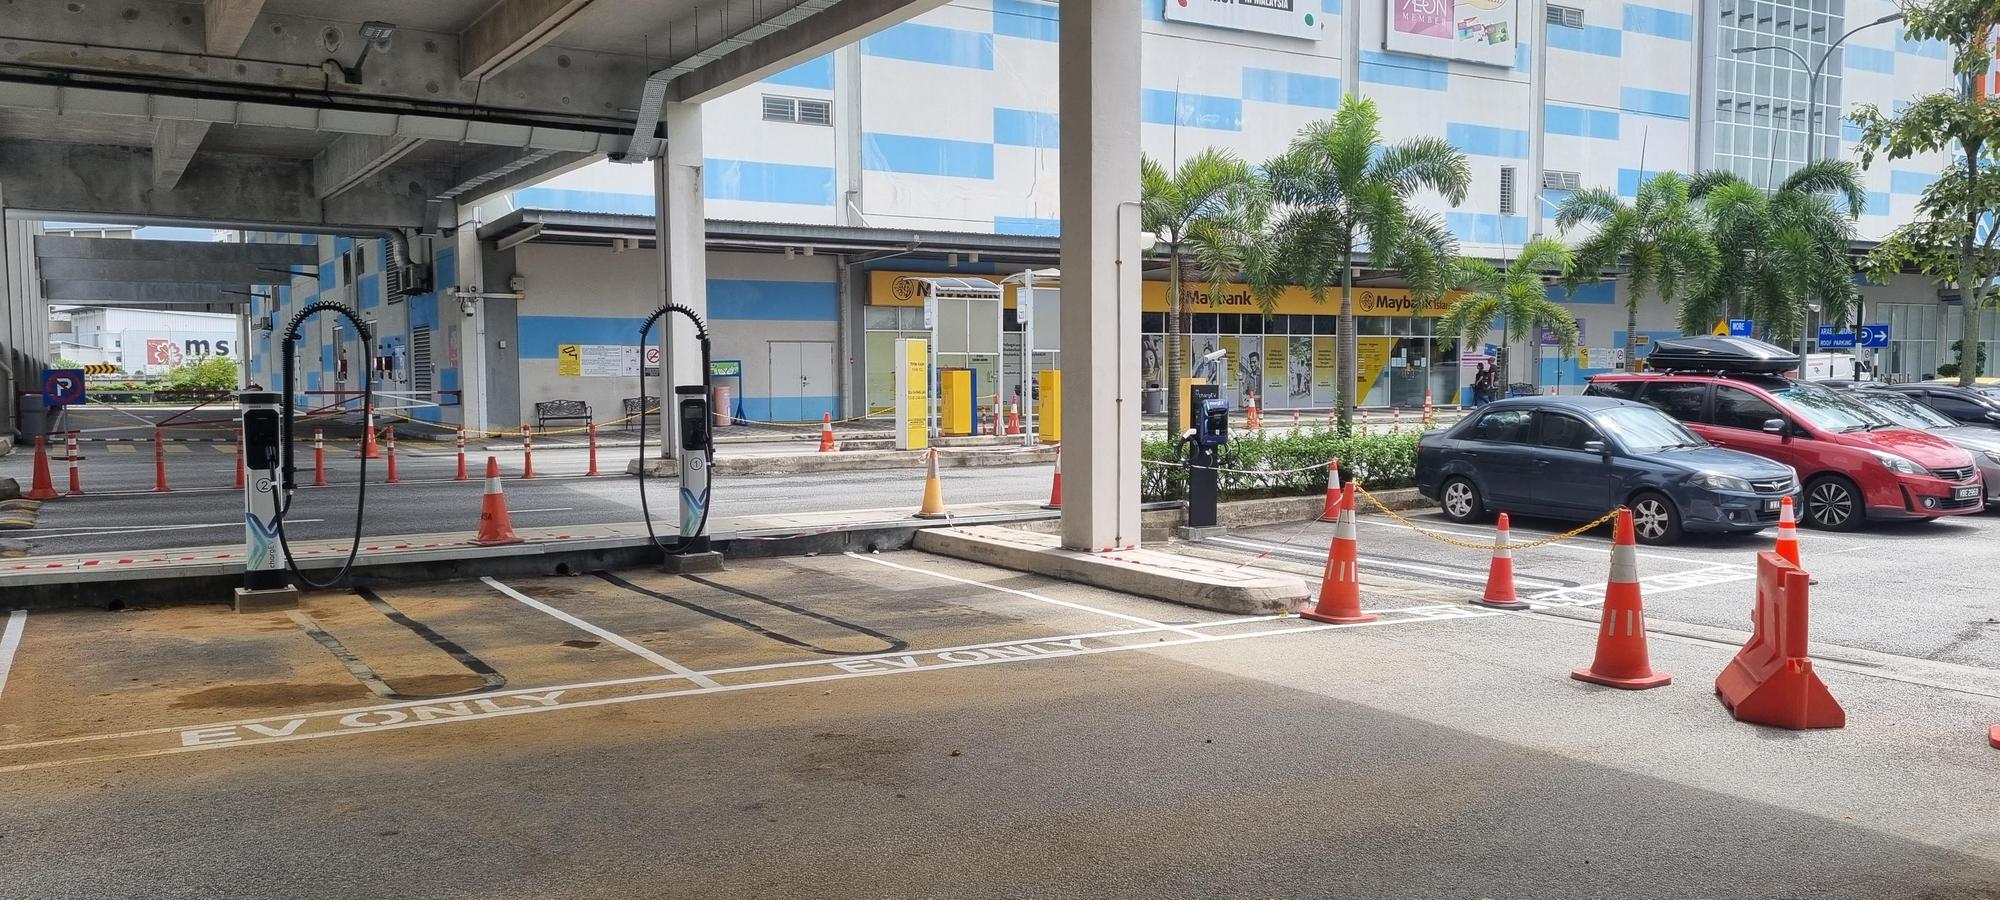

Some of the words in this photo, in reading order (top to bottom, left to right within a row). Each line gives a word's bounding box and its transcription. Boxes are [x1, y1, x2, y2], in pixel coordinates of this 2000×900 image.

[1402, 12, 1447, 25] MEMBER
[1376, 295, 1433, 312] Maybak
[185, 339, 238, 356] ms
[832, 656, 920, 672] EV
[937, 639, 1091, 663] ONLY
[181, 719, 306, 747] EV
[339, 690, 567, 729] ONLY
